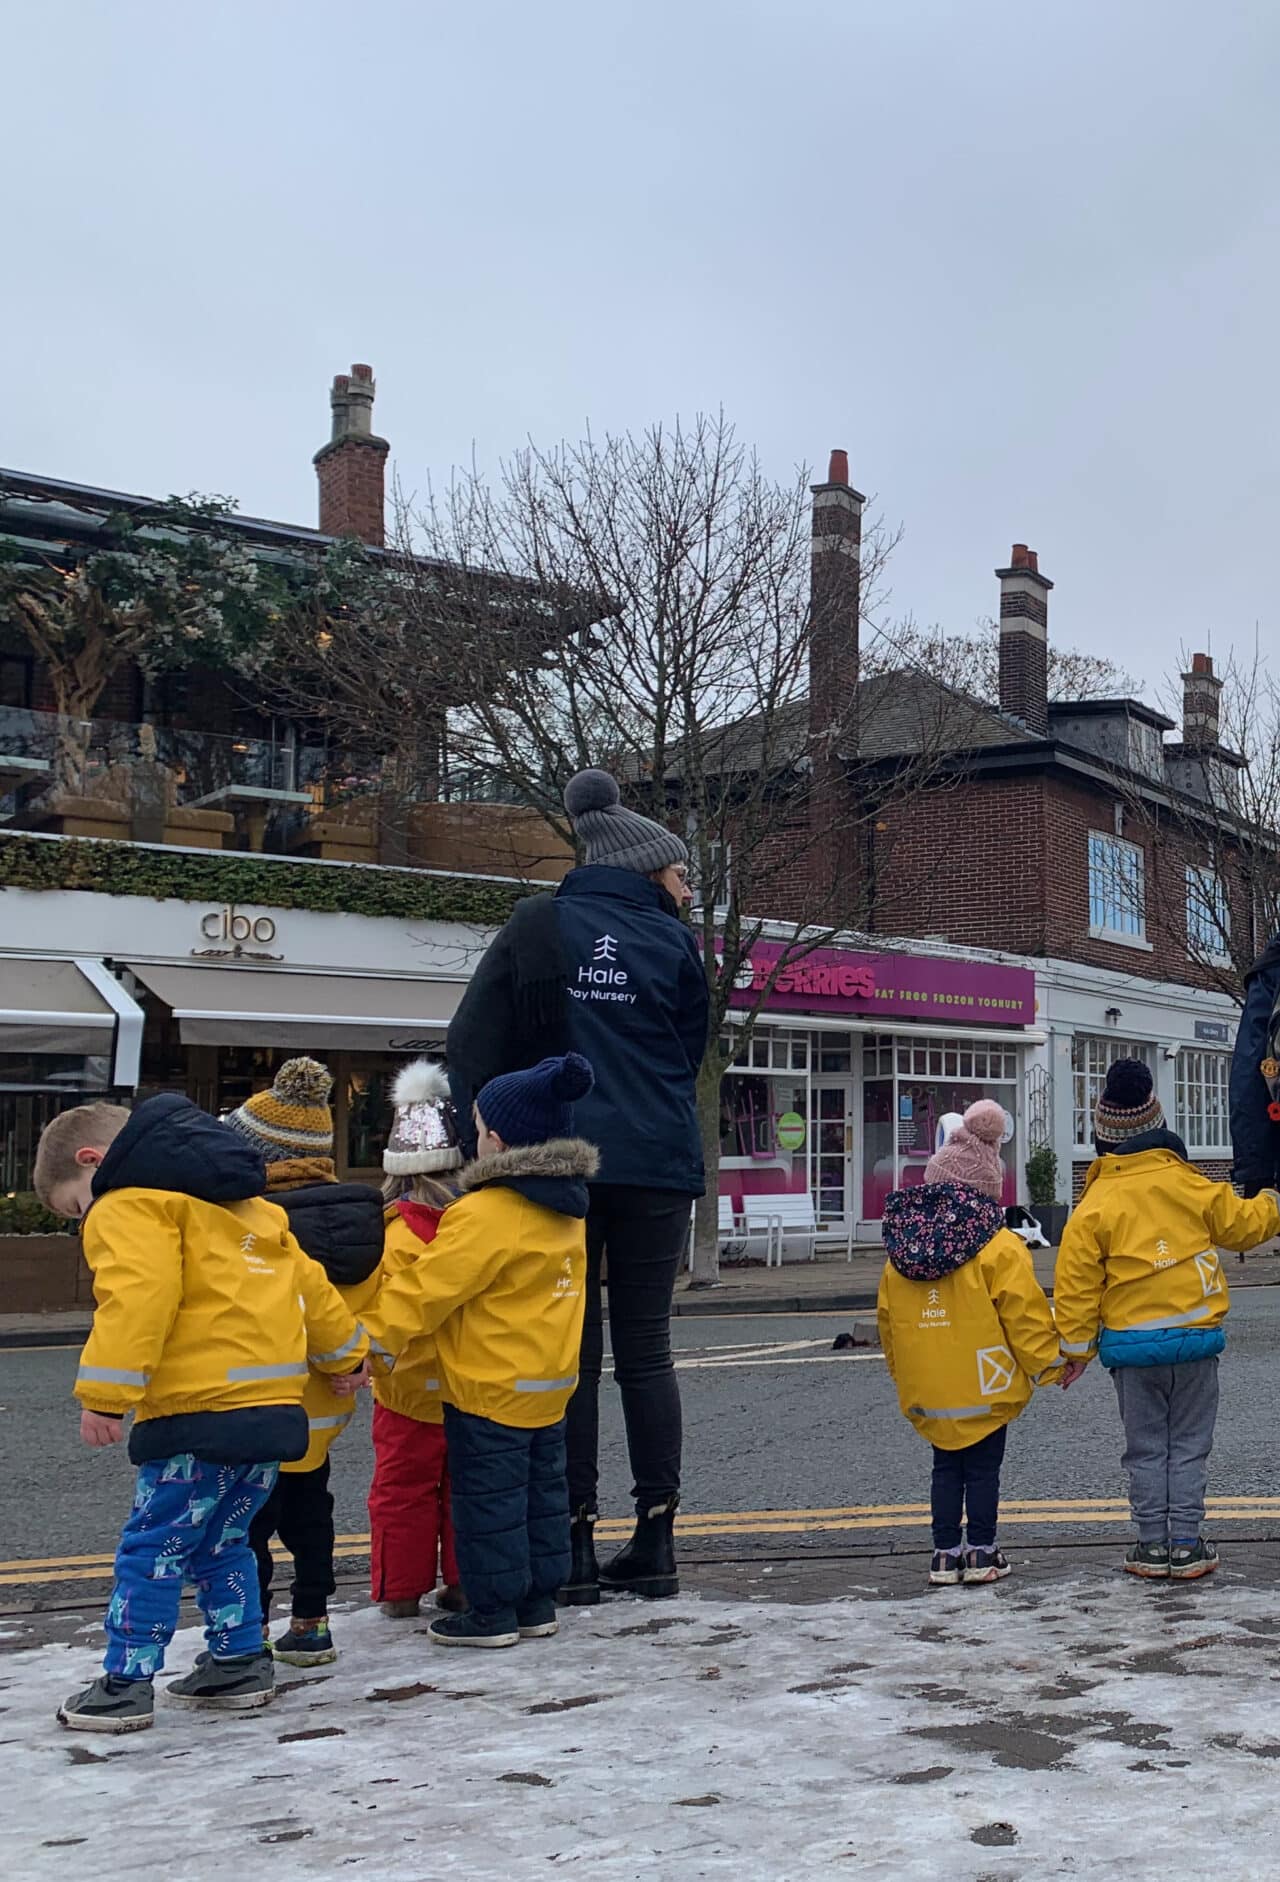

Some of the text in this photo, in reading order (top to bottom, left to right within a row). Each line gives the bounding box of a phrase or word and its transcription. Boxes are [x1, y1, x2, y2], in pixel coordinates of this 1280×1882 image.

[202, 904, 275, 942] cibo
[578, 966, 628, 985] Hale
[590, 989, 637, 1004] Nursery
[874, 988, 895, 999] FAT
[978, 997, 1024, 1011] YOGHURT
[922, 1308, 946, 1319] Hale
